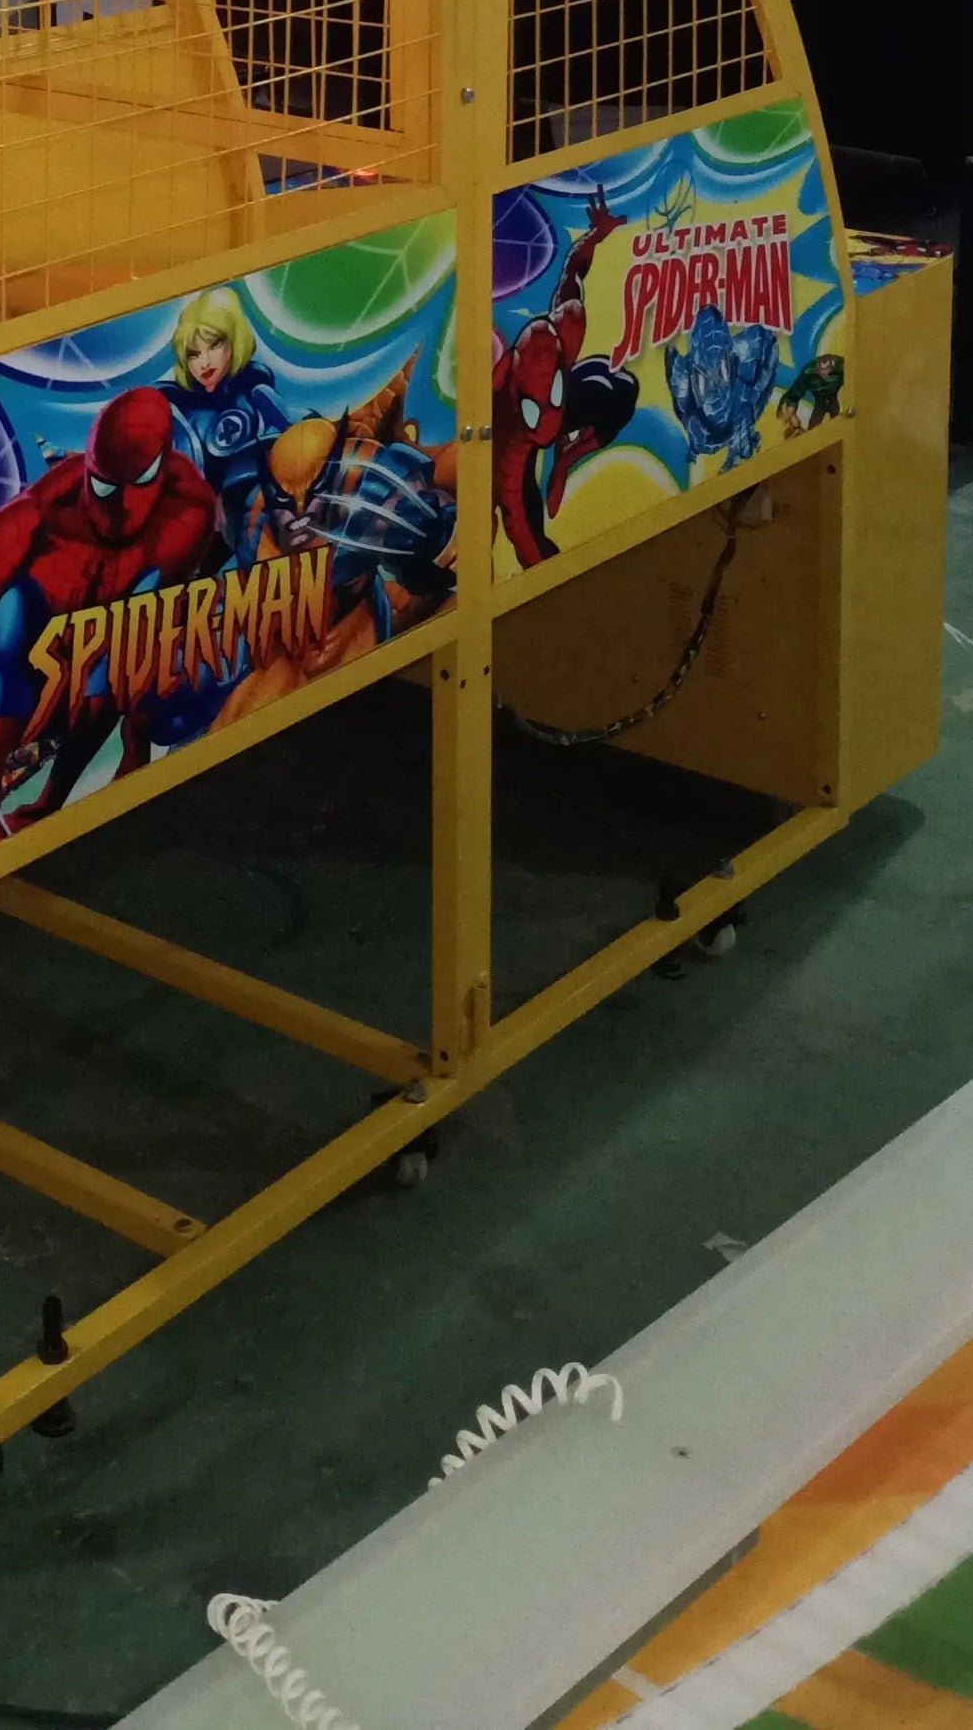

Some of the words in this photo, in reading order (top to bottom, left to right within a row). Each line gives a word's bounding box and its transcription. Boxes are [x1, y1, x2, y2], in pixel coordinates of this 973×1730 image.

[632, 214, 788, 257] ULTIMATE
[609, 240, 793, 370] SPIDER-MAN
[21, 544, 333, 743] SPIDER-MAN
